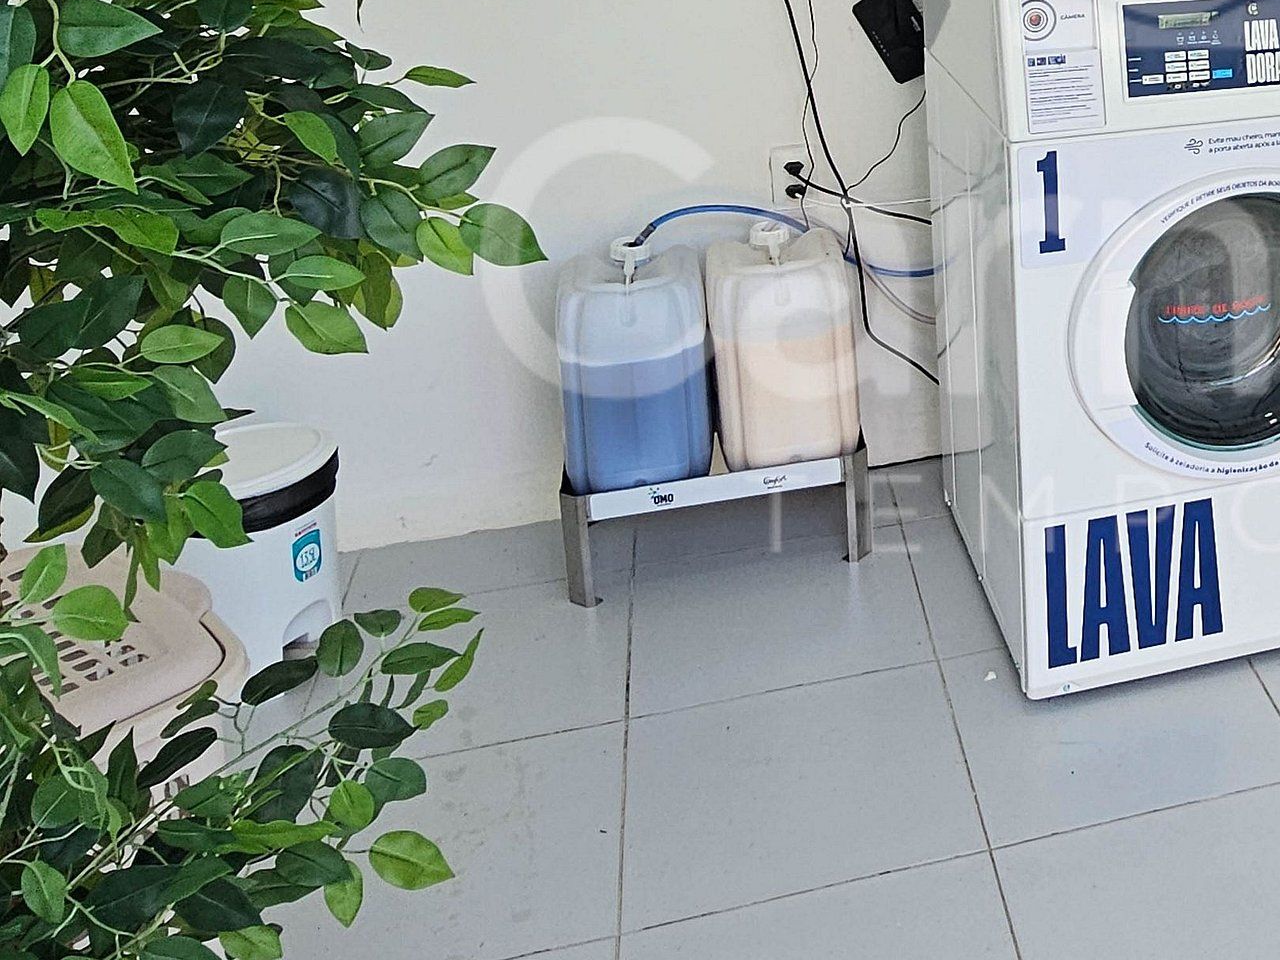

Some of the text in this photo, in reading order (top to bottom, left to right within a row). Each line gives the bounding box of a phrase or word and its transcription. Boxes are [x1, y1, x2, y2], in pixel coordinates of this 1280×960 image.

[1243, 18, 1280, 52] LAVA
[1036, 150, 1066, 254] 1
[1269, 460, 1279, 468] da
[653, 493, 674, 505] OMO
[1044, 497, 1224, 670] LAVA
